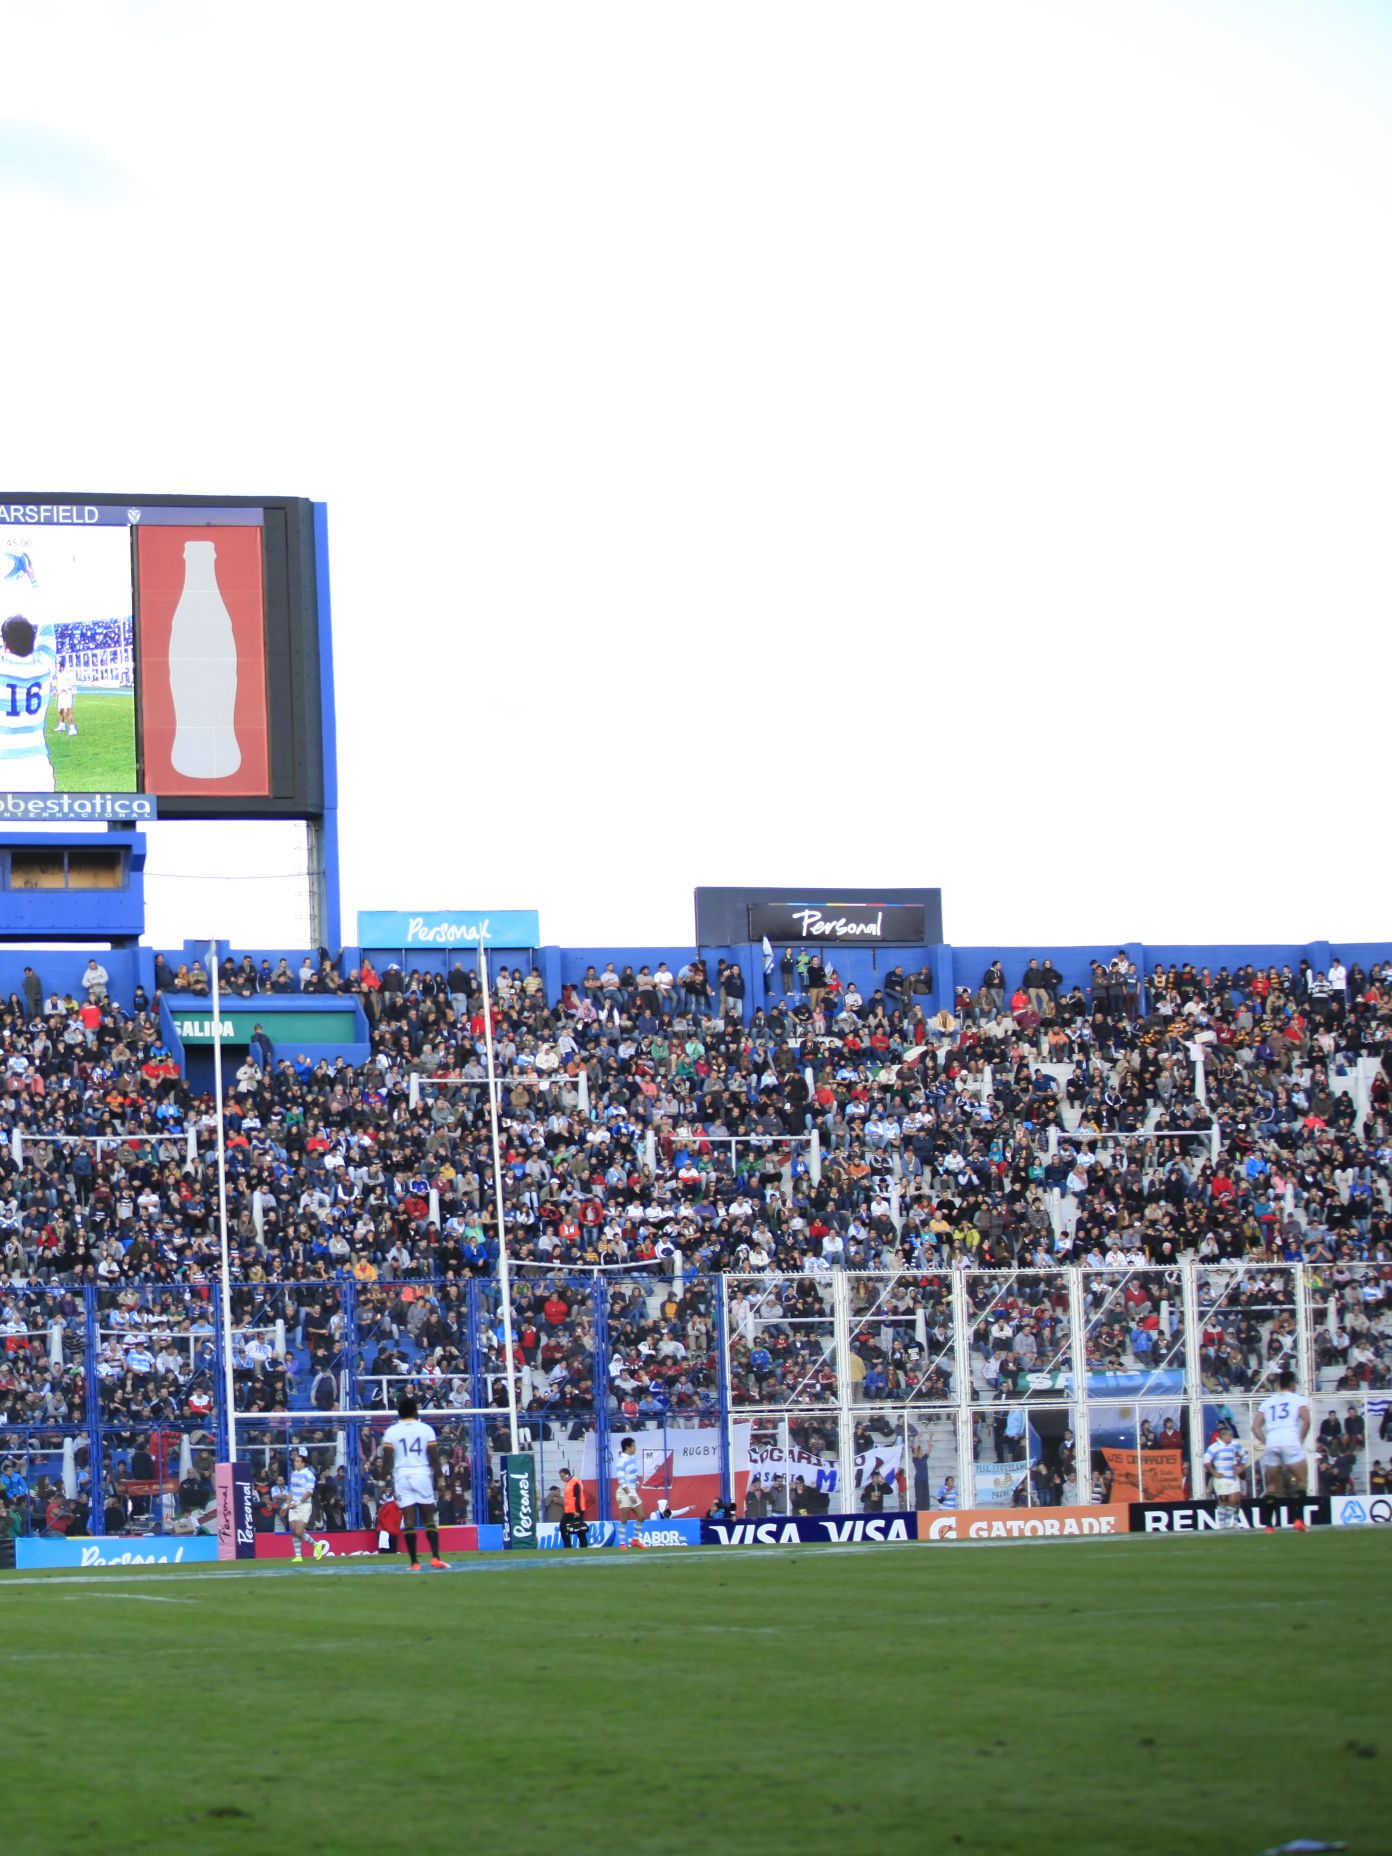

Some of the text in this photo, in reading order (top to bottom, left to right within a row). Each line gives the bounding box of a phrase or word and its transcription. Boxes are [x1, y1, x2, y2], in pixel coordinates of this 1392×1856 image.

[6, 682, 43, 717] 16
[408, 916, 493, 943] Personal
[792, 909, 883, 937] Personal
[173, 1021, 235, 1037] SALIDA
[1269, 1402, 1290, 1422] 13
[399, 1437, 423, 1457] 14
[682, 1446, 719, 1457] RUGBY
[218, 1485, 232, 1544] Personal
[235, 1482, 255, 1545] Personal
[510, 1472, 533, 1538] Personal
[708, 1519, 908, 1544] VISA VISA
[969, 1516, 1115, 1539] GATORADE
